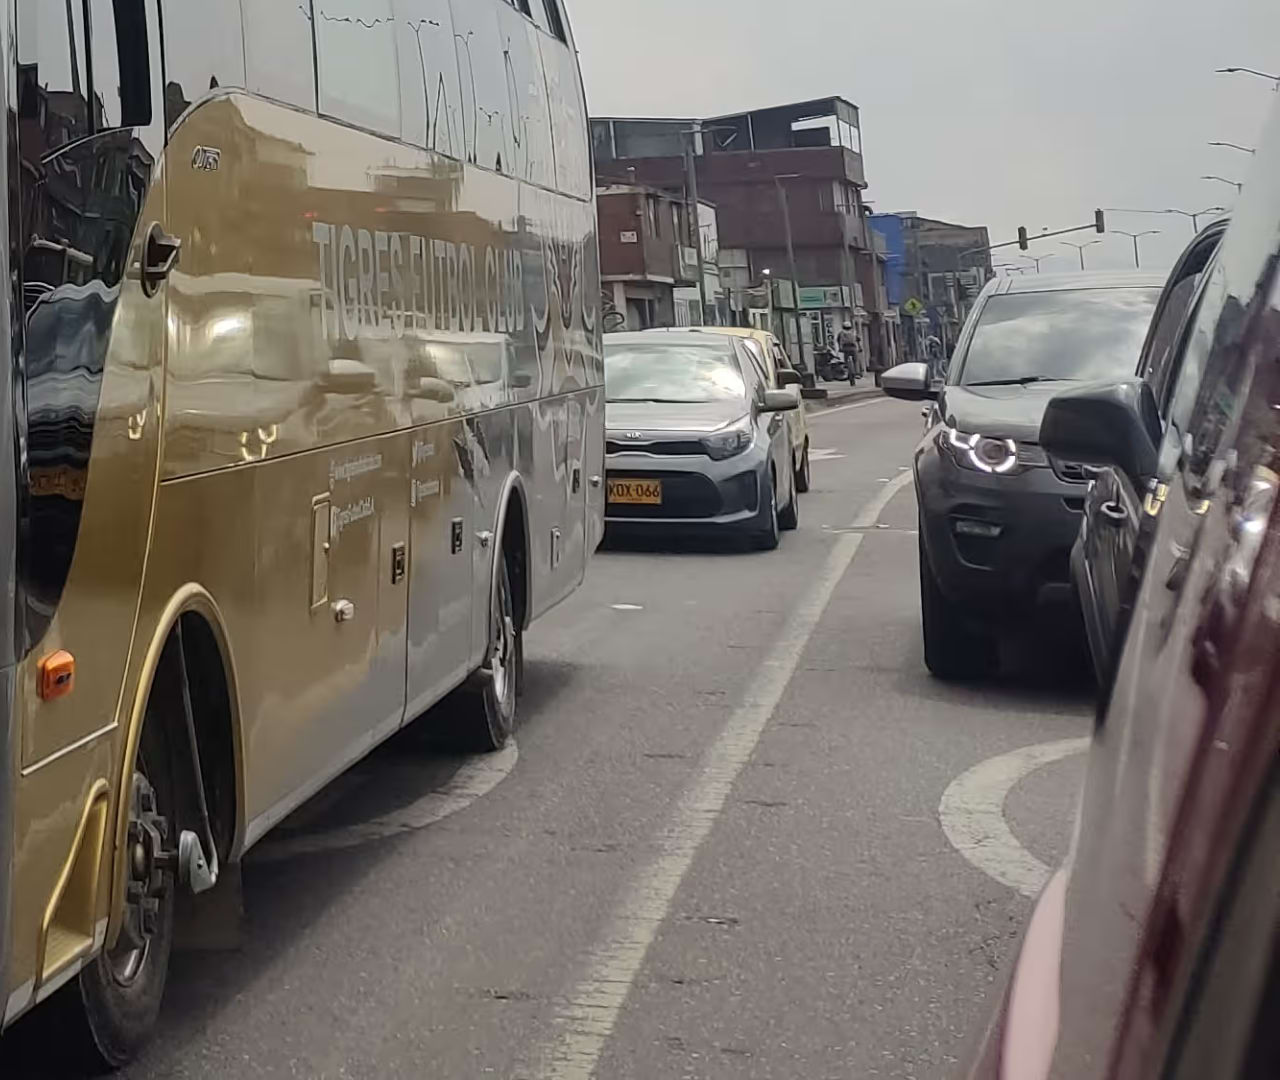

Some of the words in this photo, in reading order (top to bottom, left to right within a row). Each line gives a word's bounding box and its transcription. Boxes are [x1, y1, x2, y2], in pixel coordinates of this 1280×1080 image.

[312, 221, 405, 341] TIGRES
[409, 235, 484, 336] FUTBOL
[484, 245, 524, 334] CLUB
